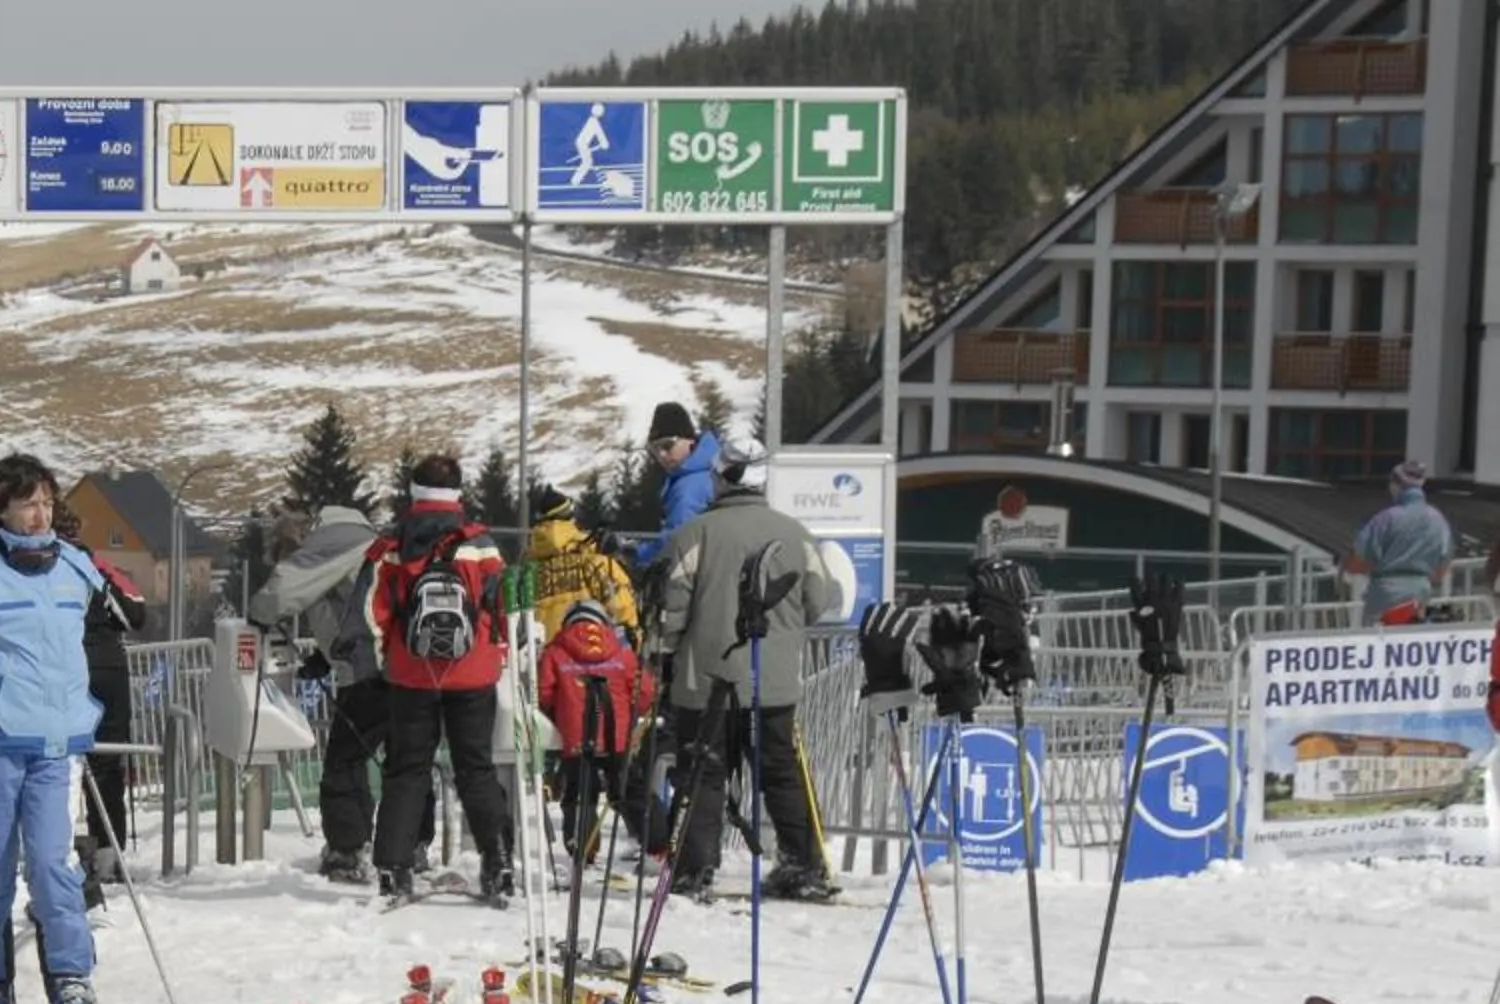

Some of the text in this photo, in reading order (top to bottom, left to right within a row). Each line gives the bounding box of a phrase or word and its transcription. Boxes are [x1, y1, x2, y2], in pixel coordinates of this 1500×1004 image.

[101, 141, 132, 155] 9.00
[668, 132, 738, 163] SOS
[285, 181, 370, 196] quattro
[812, 187, 862, 199] First aid
[663, 191, 768, 211] 602 822 645
[794, 494, 841, 508] RWE
[1265, 643, 1374, 674] PRODEJ
[1265, 668, 1440, 707] APARTMÁNŮ
